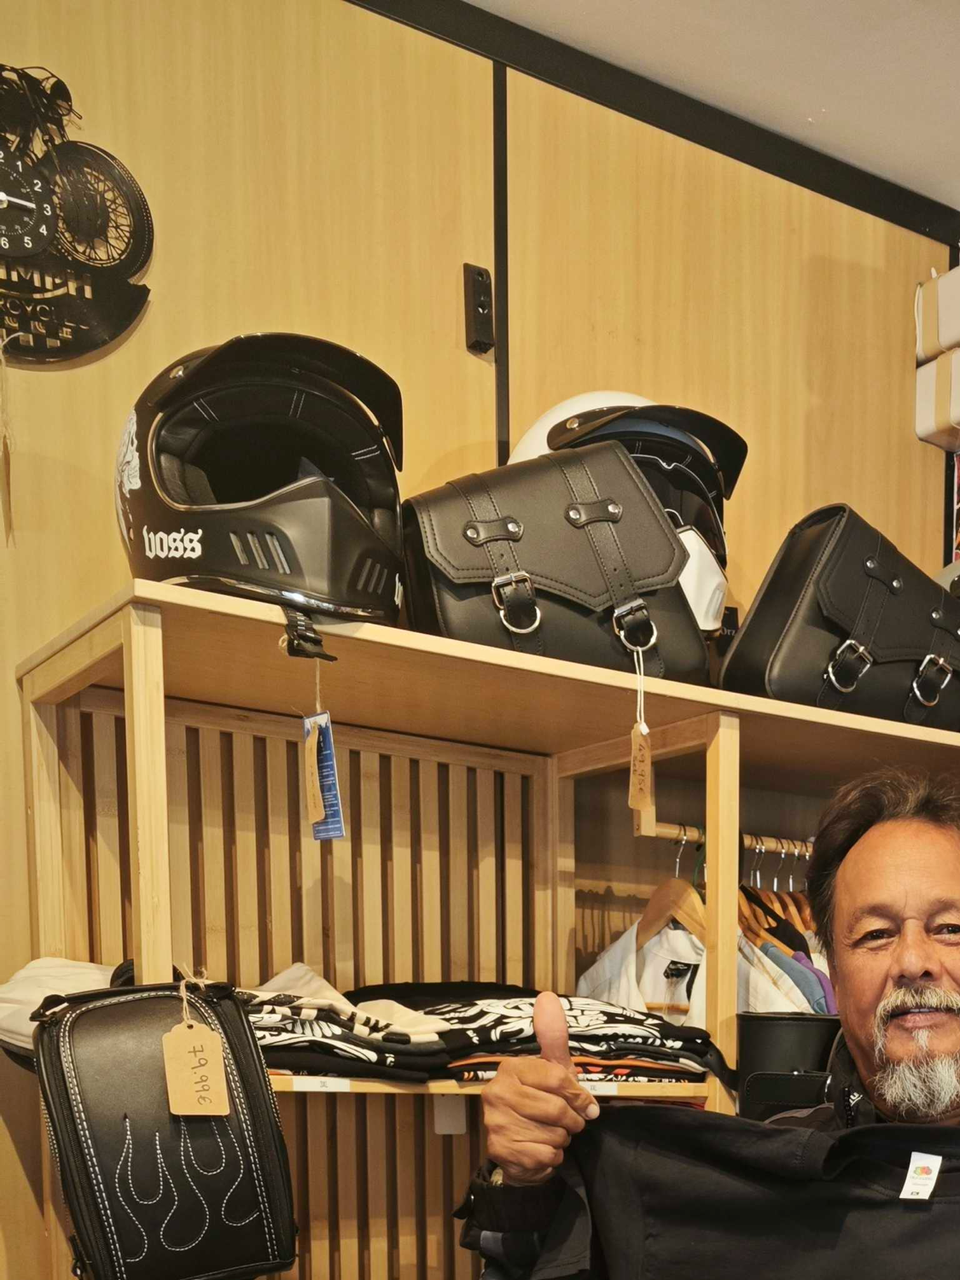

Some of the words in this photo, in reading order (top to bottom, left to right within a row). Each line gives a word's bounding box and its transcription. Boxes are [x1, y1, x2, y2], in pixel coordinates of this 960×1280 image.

[17, 161, 22, 172] 1
[33, 180, 42, 192] 2
[43, 204, 51, 215] 3
[39, 225, 48, 236] 4
[0, 237, 9, 249] 6
[24, 237, 32, 248] 5
[186, 1044, 213, 1107] 79.99€
